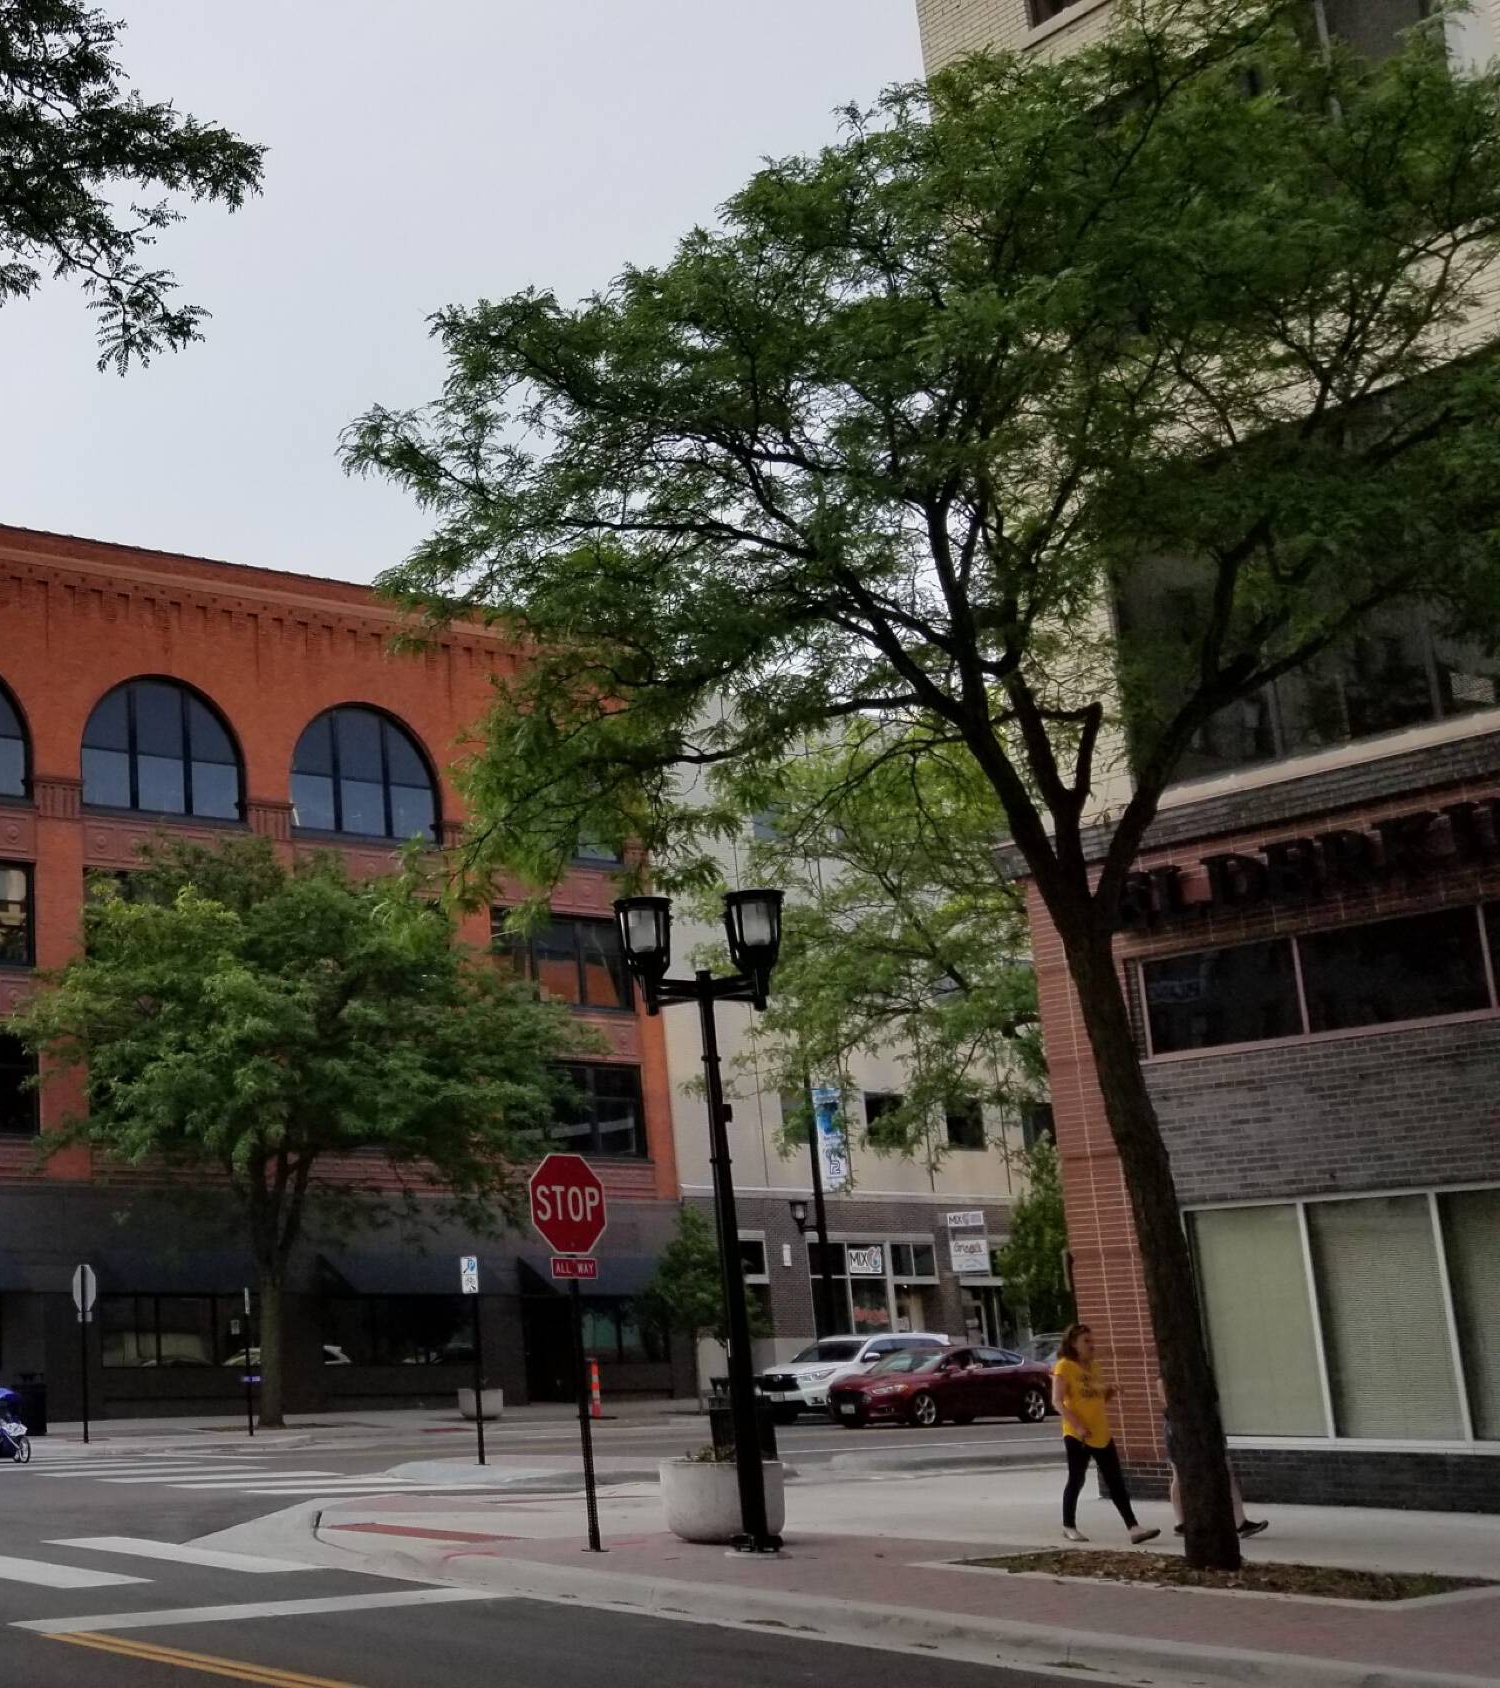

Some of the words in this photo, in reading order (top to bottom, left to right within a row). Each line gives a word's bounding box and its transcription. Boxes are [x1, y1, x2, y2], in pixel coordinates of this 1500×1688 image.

[537, 1186, 599, 1221] STOP
[949, 1215, 962, 1224] MIX
[850, 1252, 868, 1266] MIX
[556, 1263, 572, 1273] ALL
[577, 1264, 593, 1274] WAY
